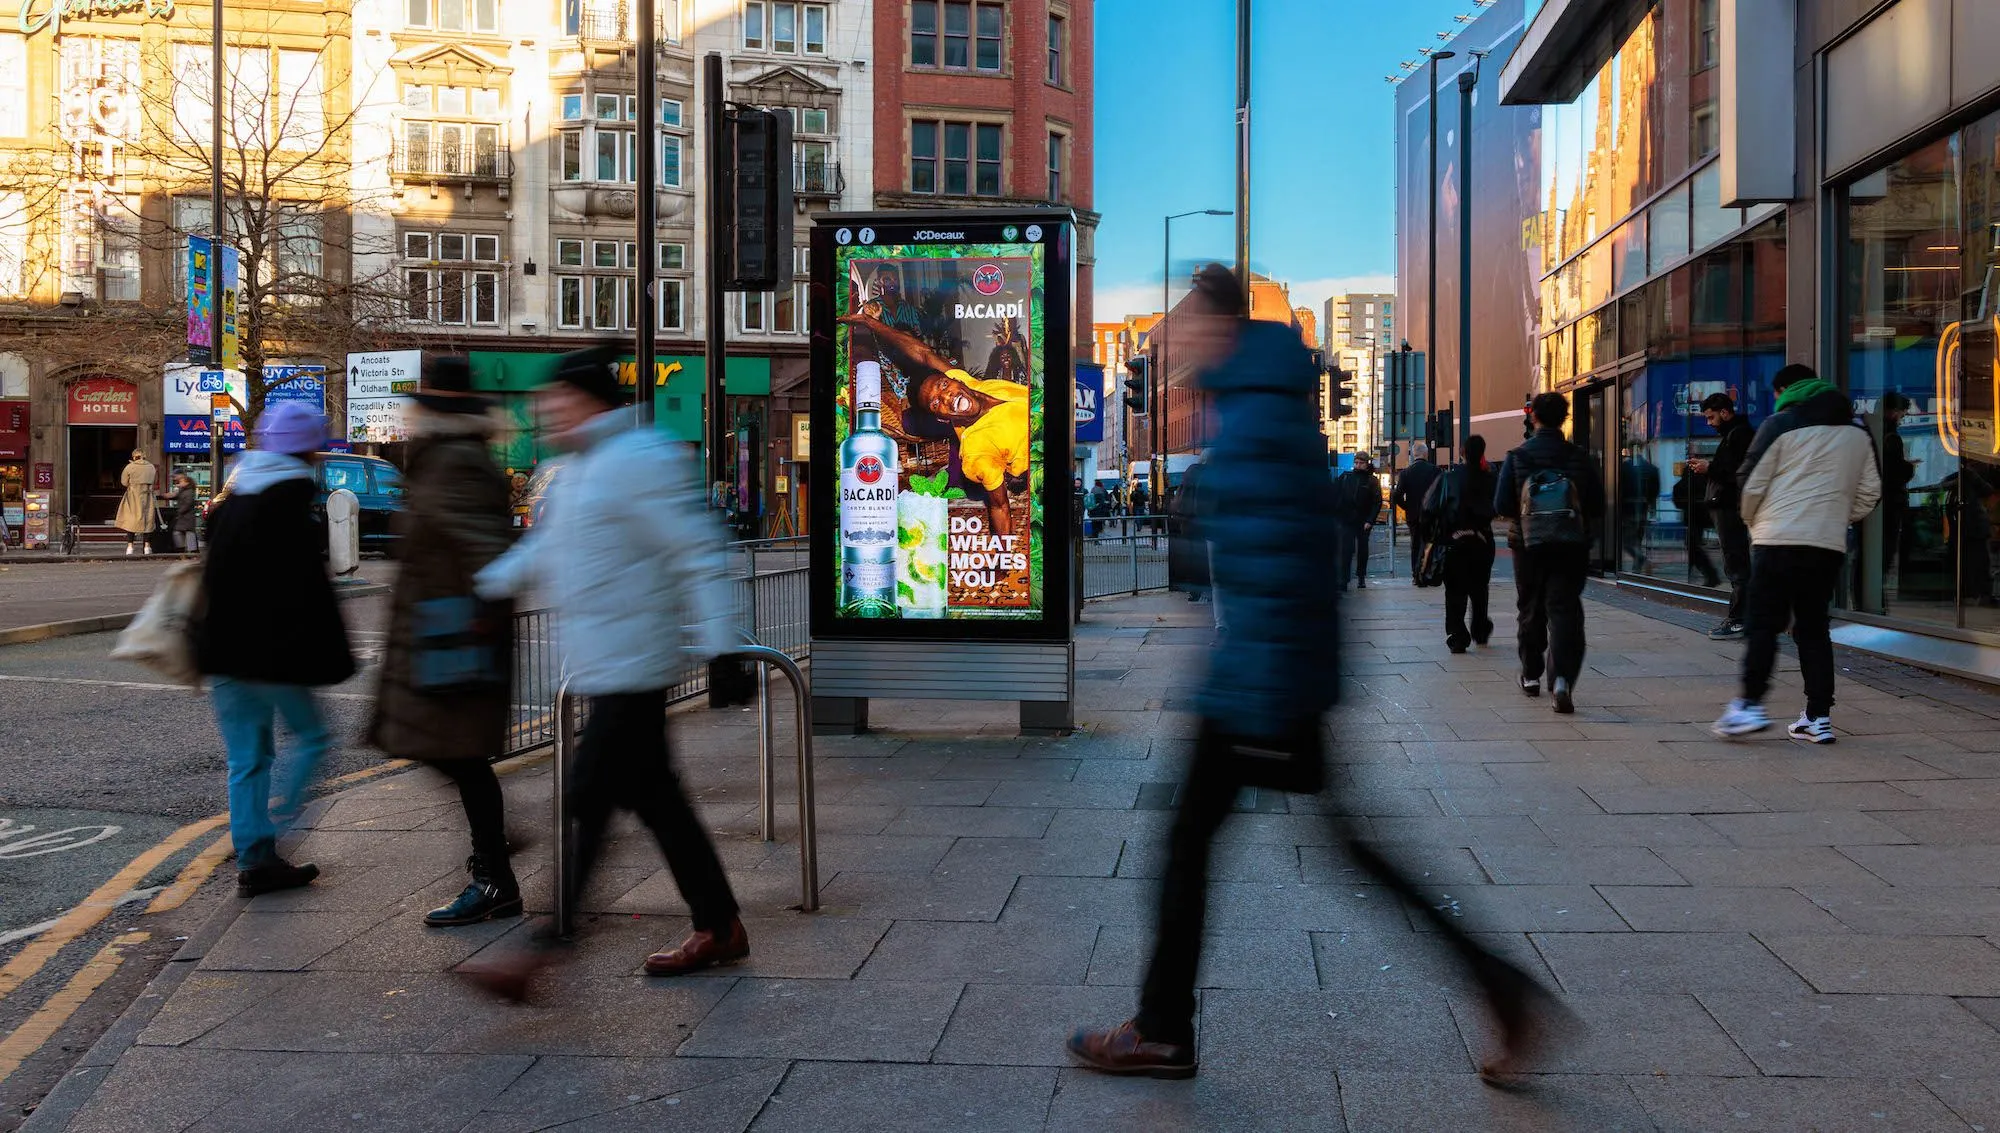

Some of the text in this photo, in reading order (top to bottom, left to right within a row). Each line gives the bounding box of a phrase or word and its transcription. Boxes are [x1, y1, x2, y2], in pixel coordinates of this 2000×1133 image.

[913, 230, 965, 240] JCDecaux
[954, 299, 1022, 319] BACARDÍ
[360, 356, 390, 365] Ancoats
[360, 367, 405, 377] Victoria Stn
[360, 382, 416, 393] Oldham (A62)
[73, 386, 134, 402] Gardens
[83, 404, 127, 413] HOTEL
[350, 401, 401, 412] Piccadilly Stn
[350, 414, 396, 424] The SOUTH
[38, 473, 51, 483] 55
[843, 485, 896, 501] BACARDÍ
[950, 516, 982, 534] DO
[950, 534, 1018, 552] WHAT
[950, 552, 1027, 570] MOVES
[950, 570, 996, 588] YOU
